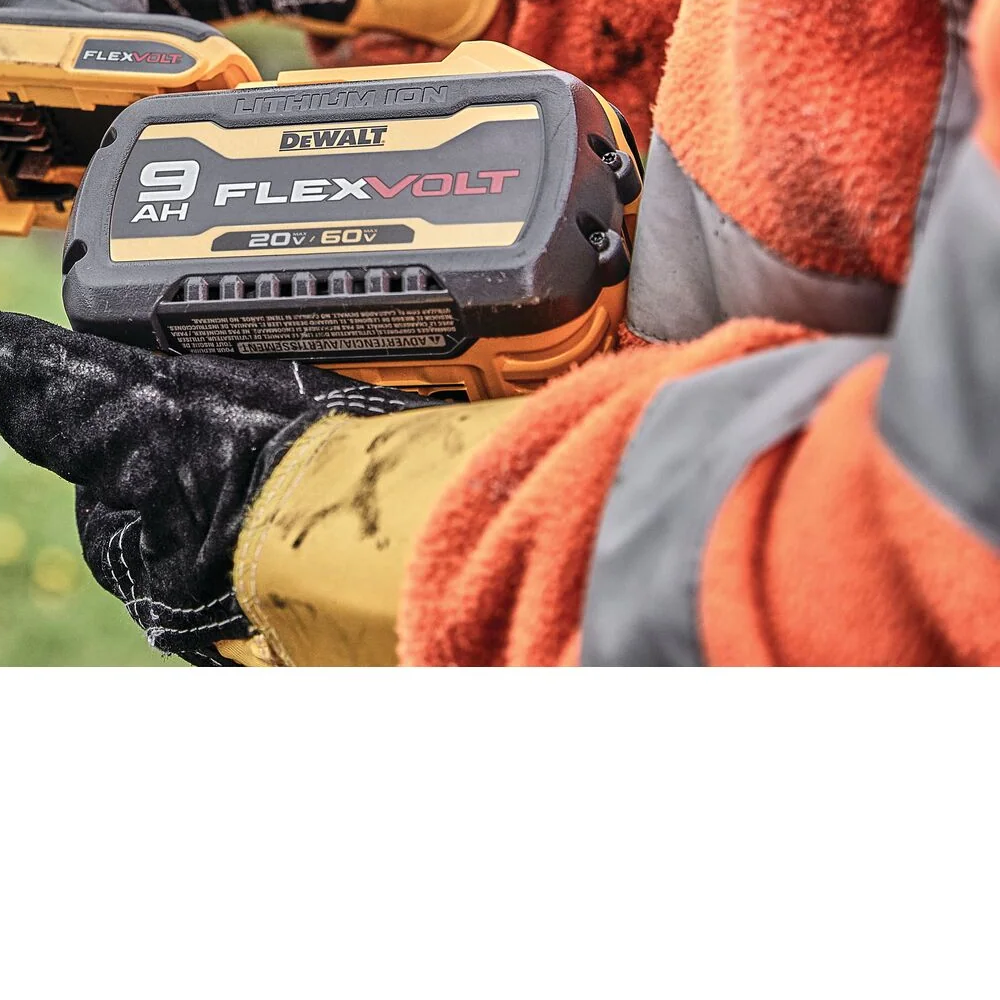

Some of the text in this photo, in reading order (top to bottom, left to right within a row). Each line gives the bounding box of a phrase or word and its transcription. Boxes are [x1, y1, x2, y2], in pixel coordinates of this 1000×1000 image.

[83, 50, 182, 64] FLEXVOLT
[234, 85, 449, 116] LITHIUM ION
[138, 160, 200, 202] 9
[214, 169, 520, 206] FLEXVOLT
[131, 203, 189, 222] AH
